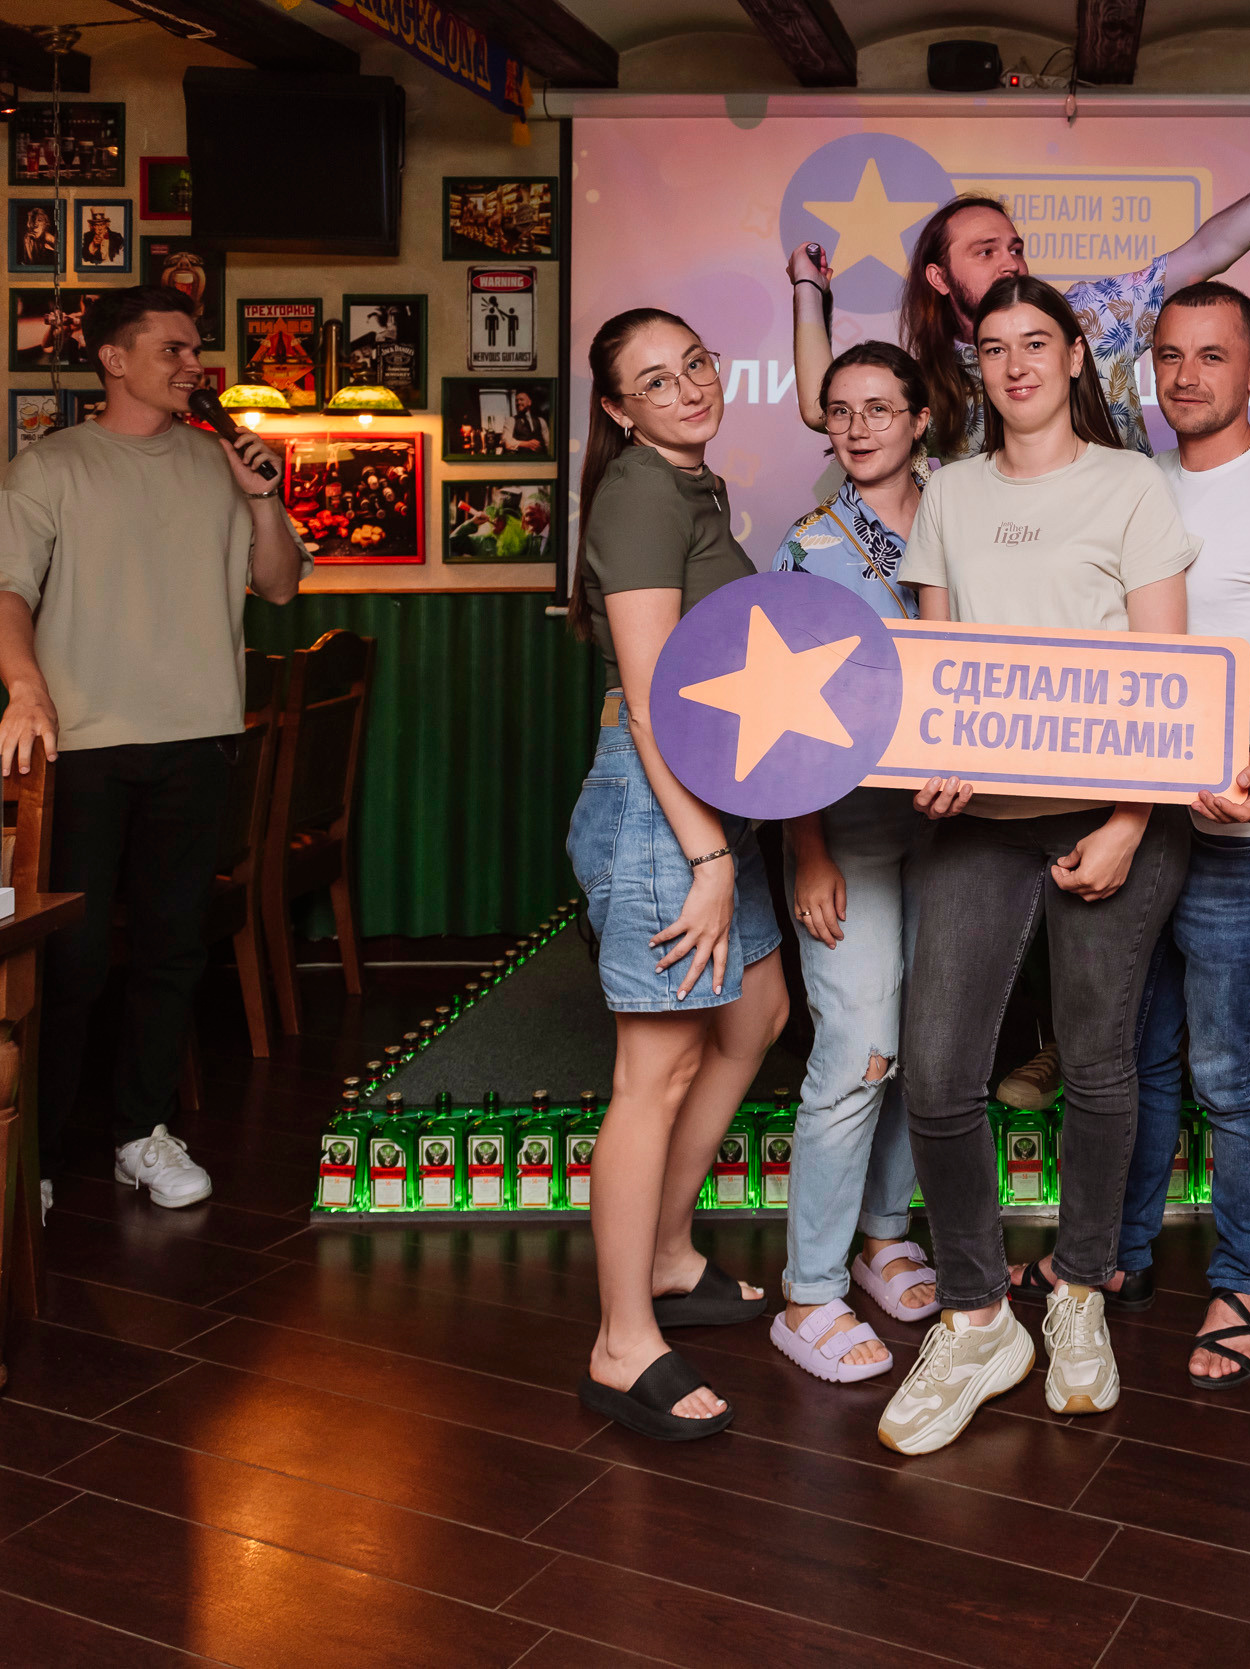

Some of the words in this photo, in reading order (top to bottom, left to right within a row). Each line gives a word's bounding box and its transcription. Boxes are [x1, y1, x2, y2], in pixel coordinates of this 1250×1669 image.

[336, 0, 492, 91] RCELONA
[1111, 196, 1151, 222] ЭТО
[1022, 232, 1156, 261] ОЛЛЕГАМИ!
[479, 276, 525, 287] WARNING
[715, 360, 799, 404] ЛИ
[994, 525, 1041, 547] light
[1009, 524, 1024, 532] the
[932, 659, 1109, 705] СДЕЛАЛИ
[1118, 670, 1188, 709] ЭТО
[919, 708, 944, 745] С
[953, 710, 1195, 761] КОЛЛЕГАМИ!
